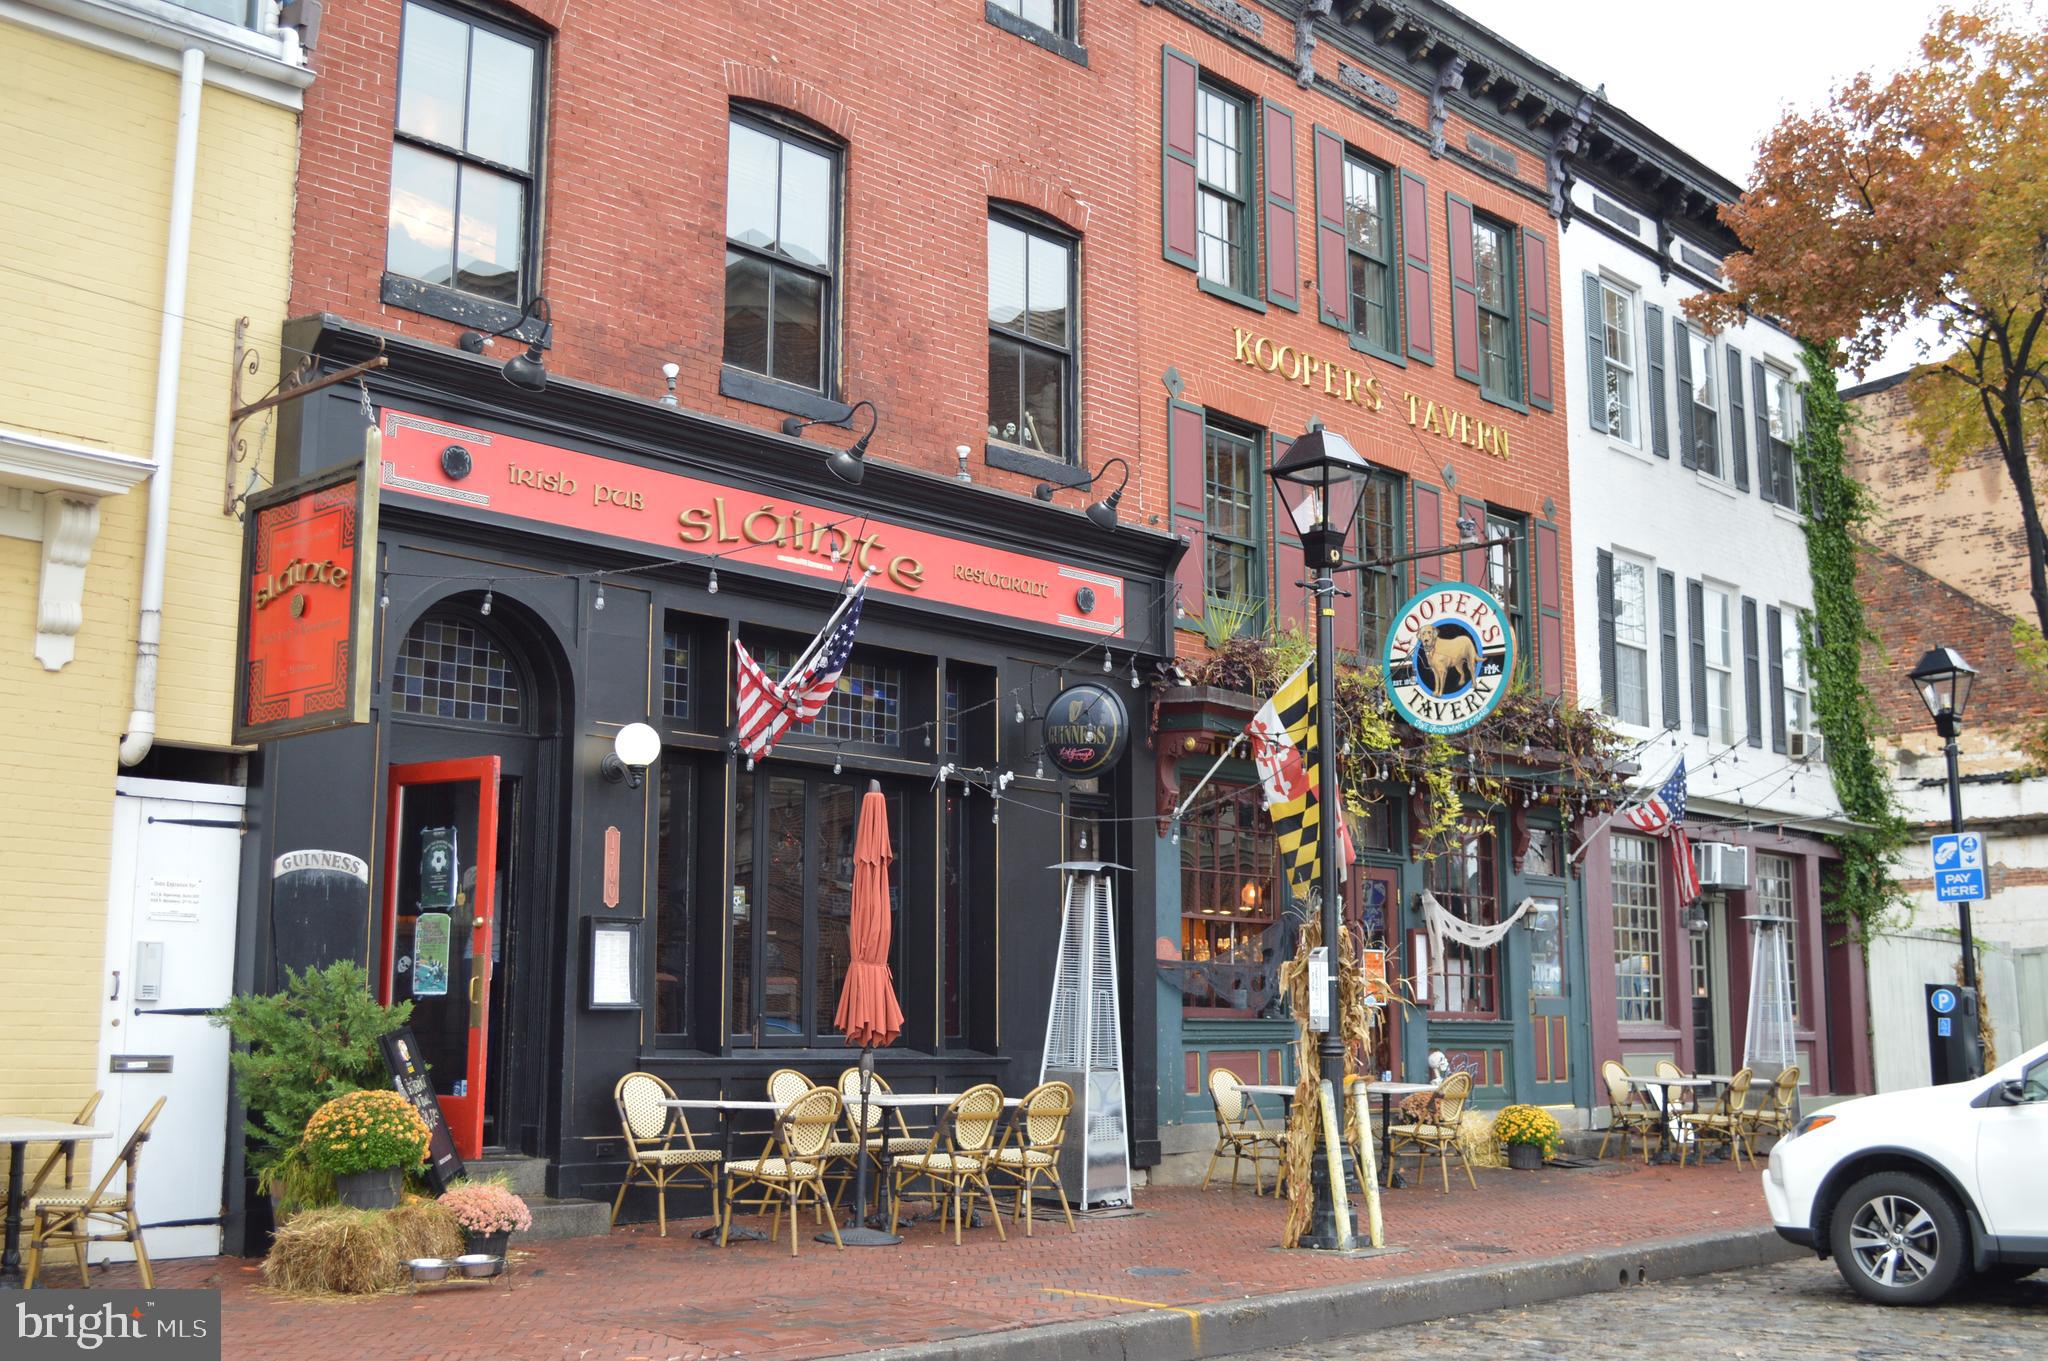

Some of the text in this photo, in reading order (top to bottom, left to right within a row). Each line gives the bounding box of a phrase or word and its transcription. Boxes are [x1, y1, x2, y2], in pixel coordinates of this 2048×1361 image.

[1233, 326, 1510, 460] KOOPERS TAVERN
[1393, 593, 1501, 655] KOOPER'S
[1408, 680, 1493, 721] TAVERN
[1048, 725, 1106, 745] GUINNESS
[282, 853, 361, 874] GUINNESS
[1945, 873, 1971, 884] PAY
[1941, 885, 1979, 897] HERE
